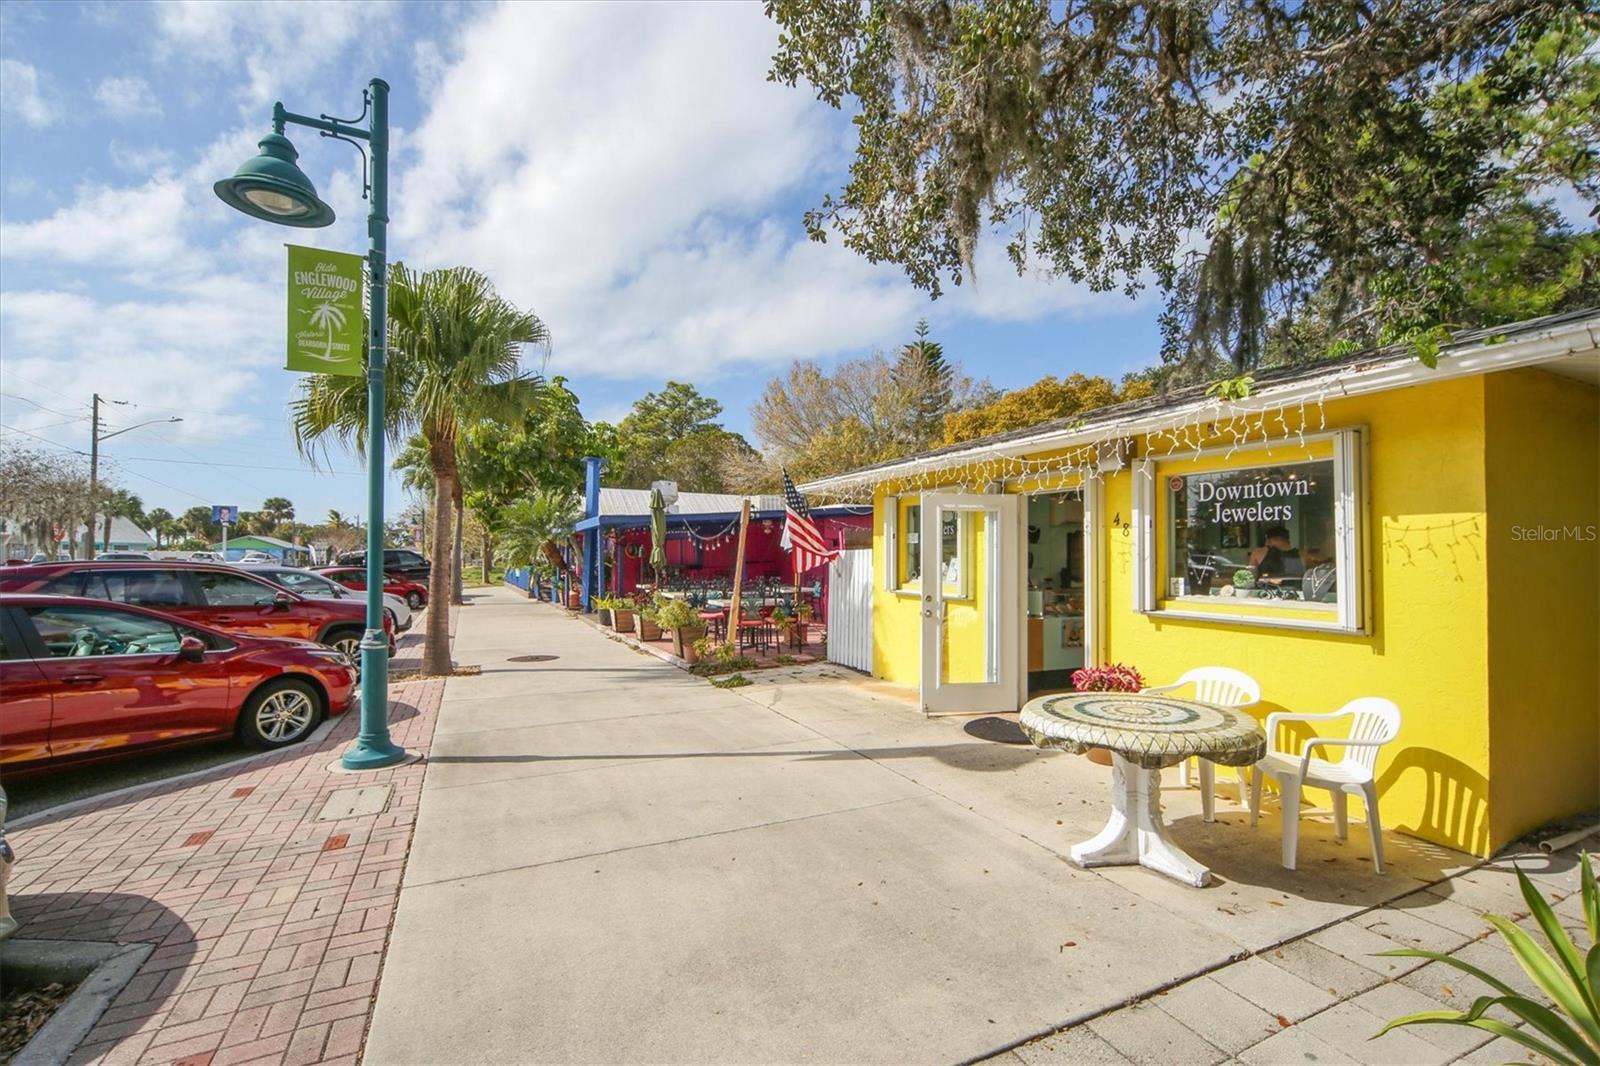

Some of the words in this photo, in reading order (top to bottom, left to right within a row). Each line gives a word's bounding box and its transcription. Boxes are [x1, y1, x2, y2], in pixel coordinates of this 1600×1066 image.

[295, 272, 357, 292] ENGLEWOOD
[301, 287, 347, 301] Village
[1199, 479, 1310, 502] Downtown
[1212, 502, 1292, 524] Jewelers
